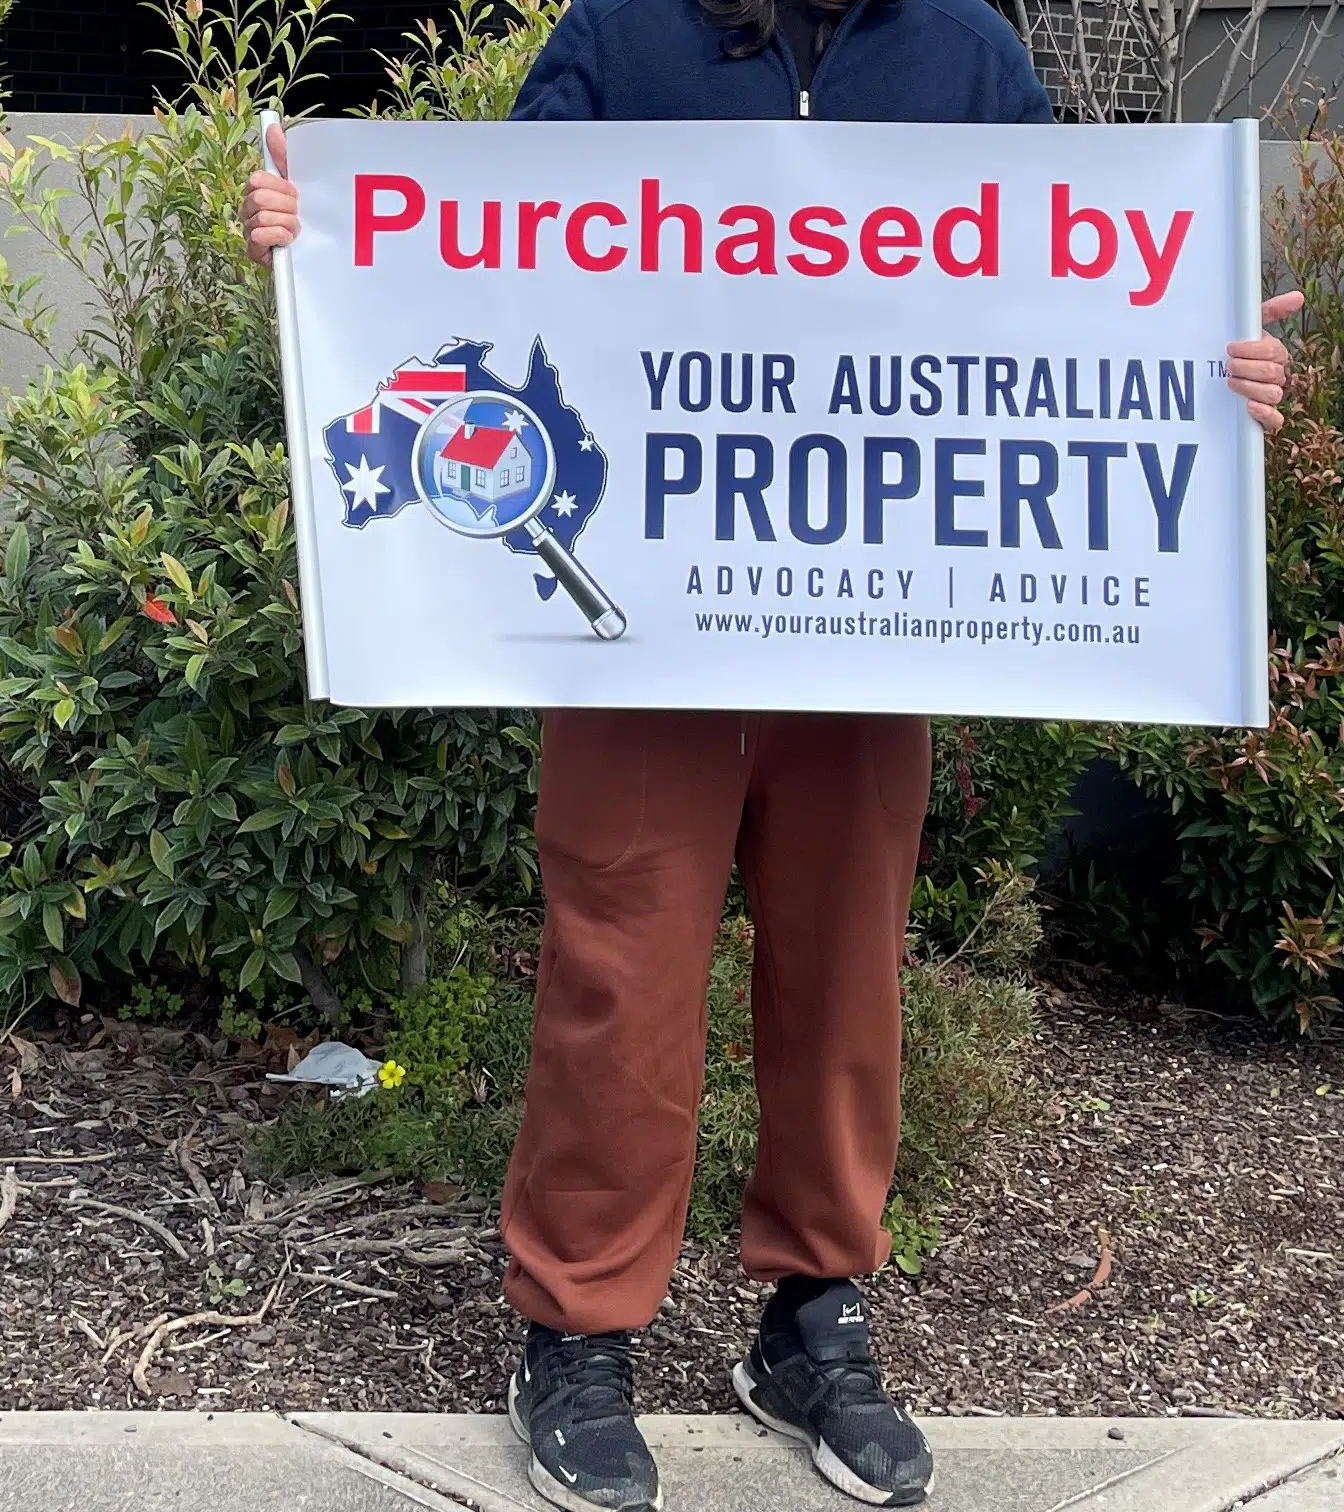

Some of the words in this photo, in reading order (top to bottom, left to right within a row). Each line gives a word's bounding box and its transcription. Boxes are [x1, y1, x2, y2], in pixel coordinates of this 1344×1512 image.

[353, 173, 1000, 279] Purchased
[1050, 183, 1194, 307] by
[639, 350, 797, 414] YOUR
[827, 354, 1195, 422] AUSTRALIAN
[644, 431, 1199, 553] PROPERTY
[686, 565, 914, 600] ADVOCACY
[989, 572, 1150, 607] ADVICE
[695, 611, 1141, 647] www.youraustralianproperty.com.au
